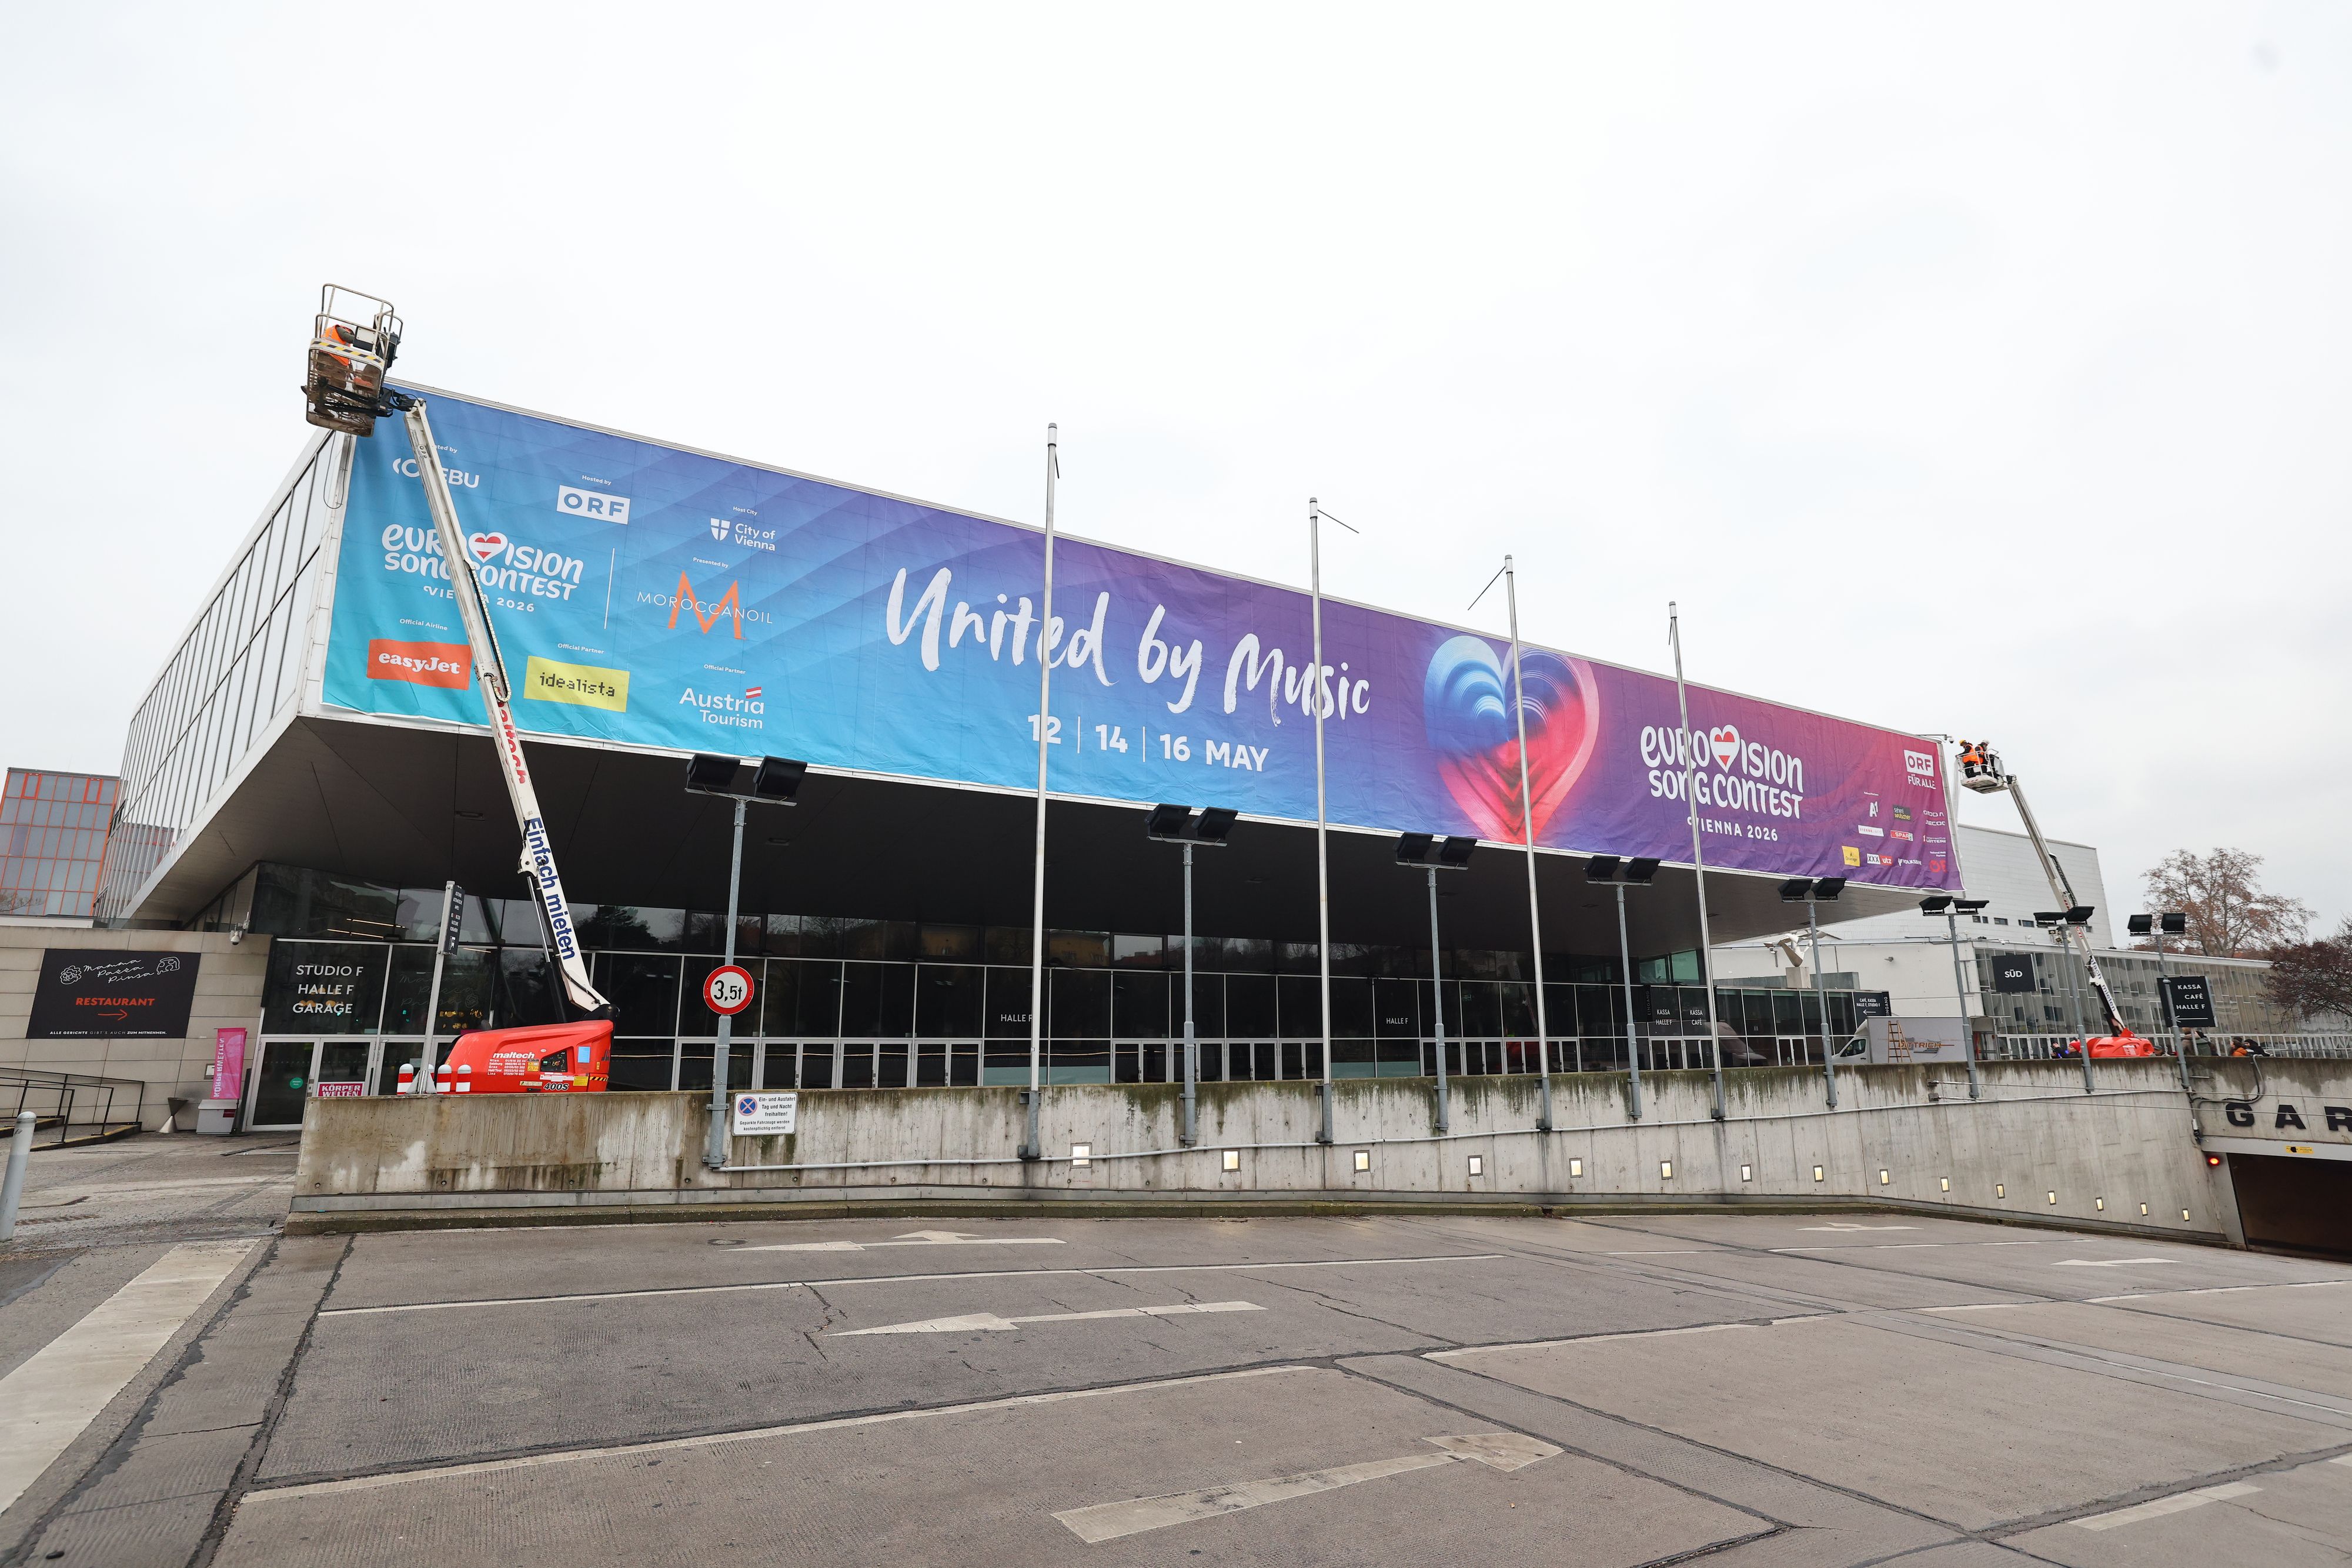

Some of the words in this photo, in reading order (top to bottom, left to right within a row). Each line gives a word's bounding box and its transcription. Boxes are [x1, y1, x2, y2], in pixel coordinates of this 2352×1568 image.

[582, 474, 603, 484] Hosted
[563, 493, 624, 517] ORF
[735, 523, 760, 539] City
[762, 529, 776, 539] of
[735, 534, 776, 551] Vienna
[693, 557, 720, 566] Presented
[721, 560, 729, 569] by
[496, 597, 535, 612] 2026
[637, 591, 773, 624] MOROCCANOIL
[399, 618, 422, 627] Official
[423, 621, 448, 631] Airline
[557, 643, 580, 651] Official
[581, 646, 604, 655] Partner
[886, 566, 1120, 687] United
[1137, 603, 1203, 714] by
[1223, 633, 1371, 727] Music
[378, 651, 460, 675] easyJet
[704, 664, 723, 672] Official
[724, 667, 746, 675] Partner
[539, 672, 616, 697] idealista
[679, 687, 764, 715] Austria
[699, 710, 763, 729] Tourism
[1028, 714, 1061, 744] 12
[1095, 724, 1128, 754] 14
[1160, 733, 1191, 763] 16
[1205, 740, 1269, 773] MAY
[1907, 755, 1932, 771] ORF
[1907, 774, 1921, 786] FÜR
[1713, 773, 1803, 819] CONTEST
[1869, 801, 1879, 817] A1
[1747, 824, 1778, 841] 2026
[524, 817, 559, 890] Einfach
[545, 893, 576, 960] mieten
[296, 965, 352, 976] STUDIO
[356, 966, 364, 977] F
[2004, 969, 2023, 978] SÜD
[298, 984, 343, 994] HALLE
[346, 985, 354, 995] F
[713, 980, 743, 1002] 3,5t
[75, 998, 155, 1006] RESTAURANT
[292, 1002, 353, 1014] GARAGE
[1001, 1014, 1026, 1022] HALLE
